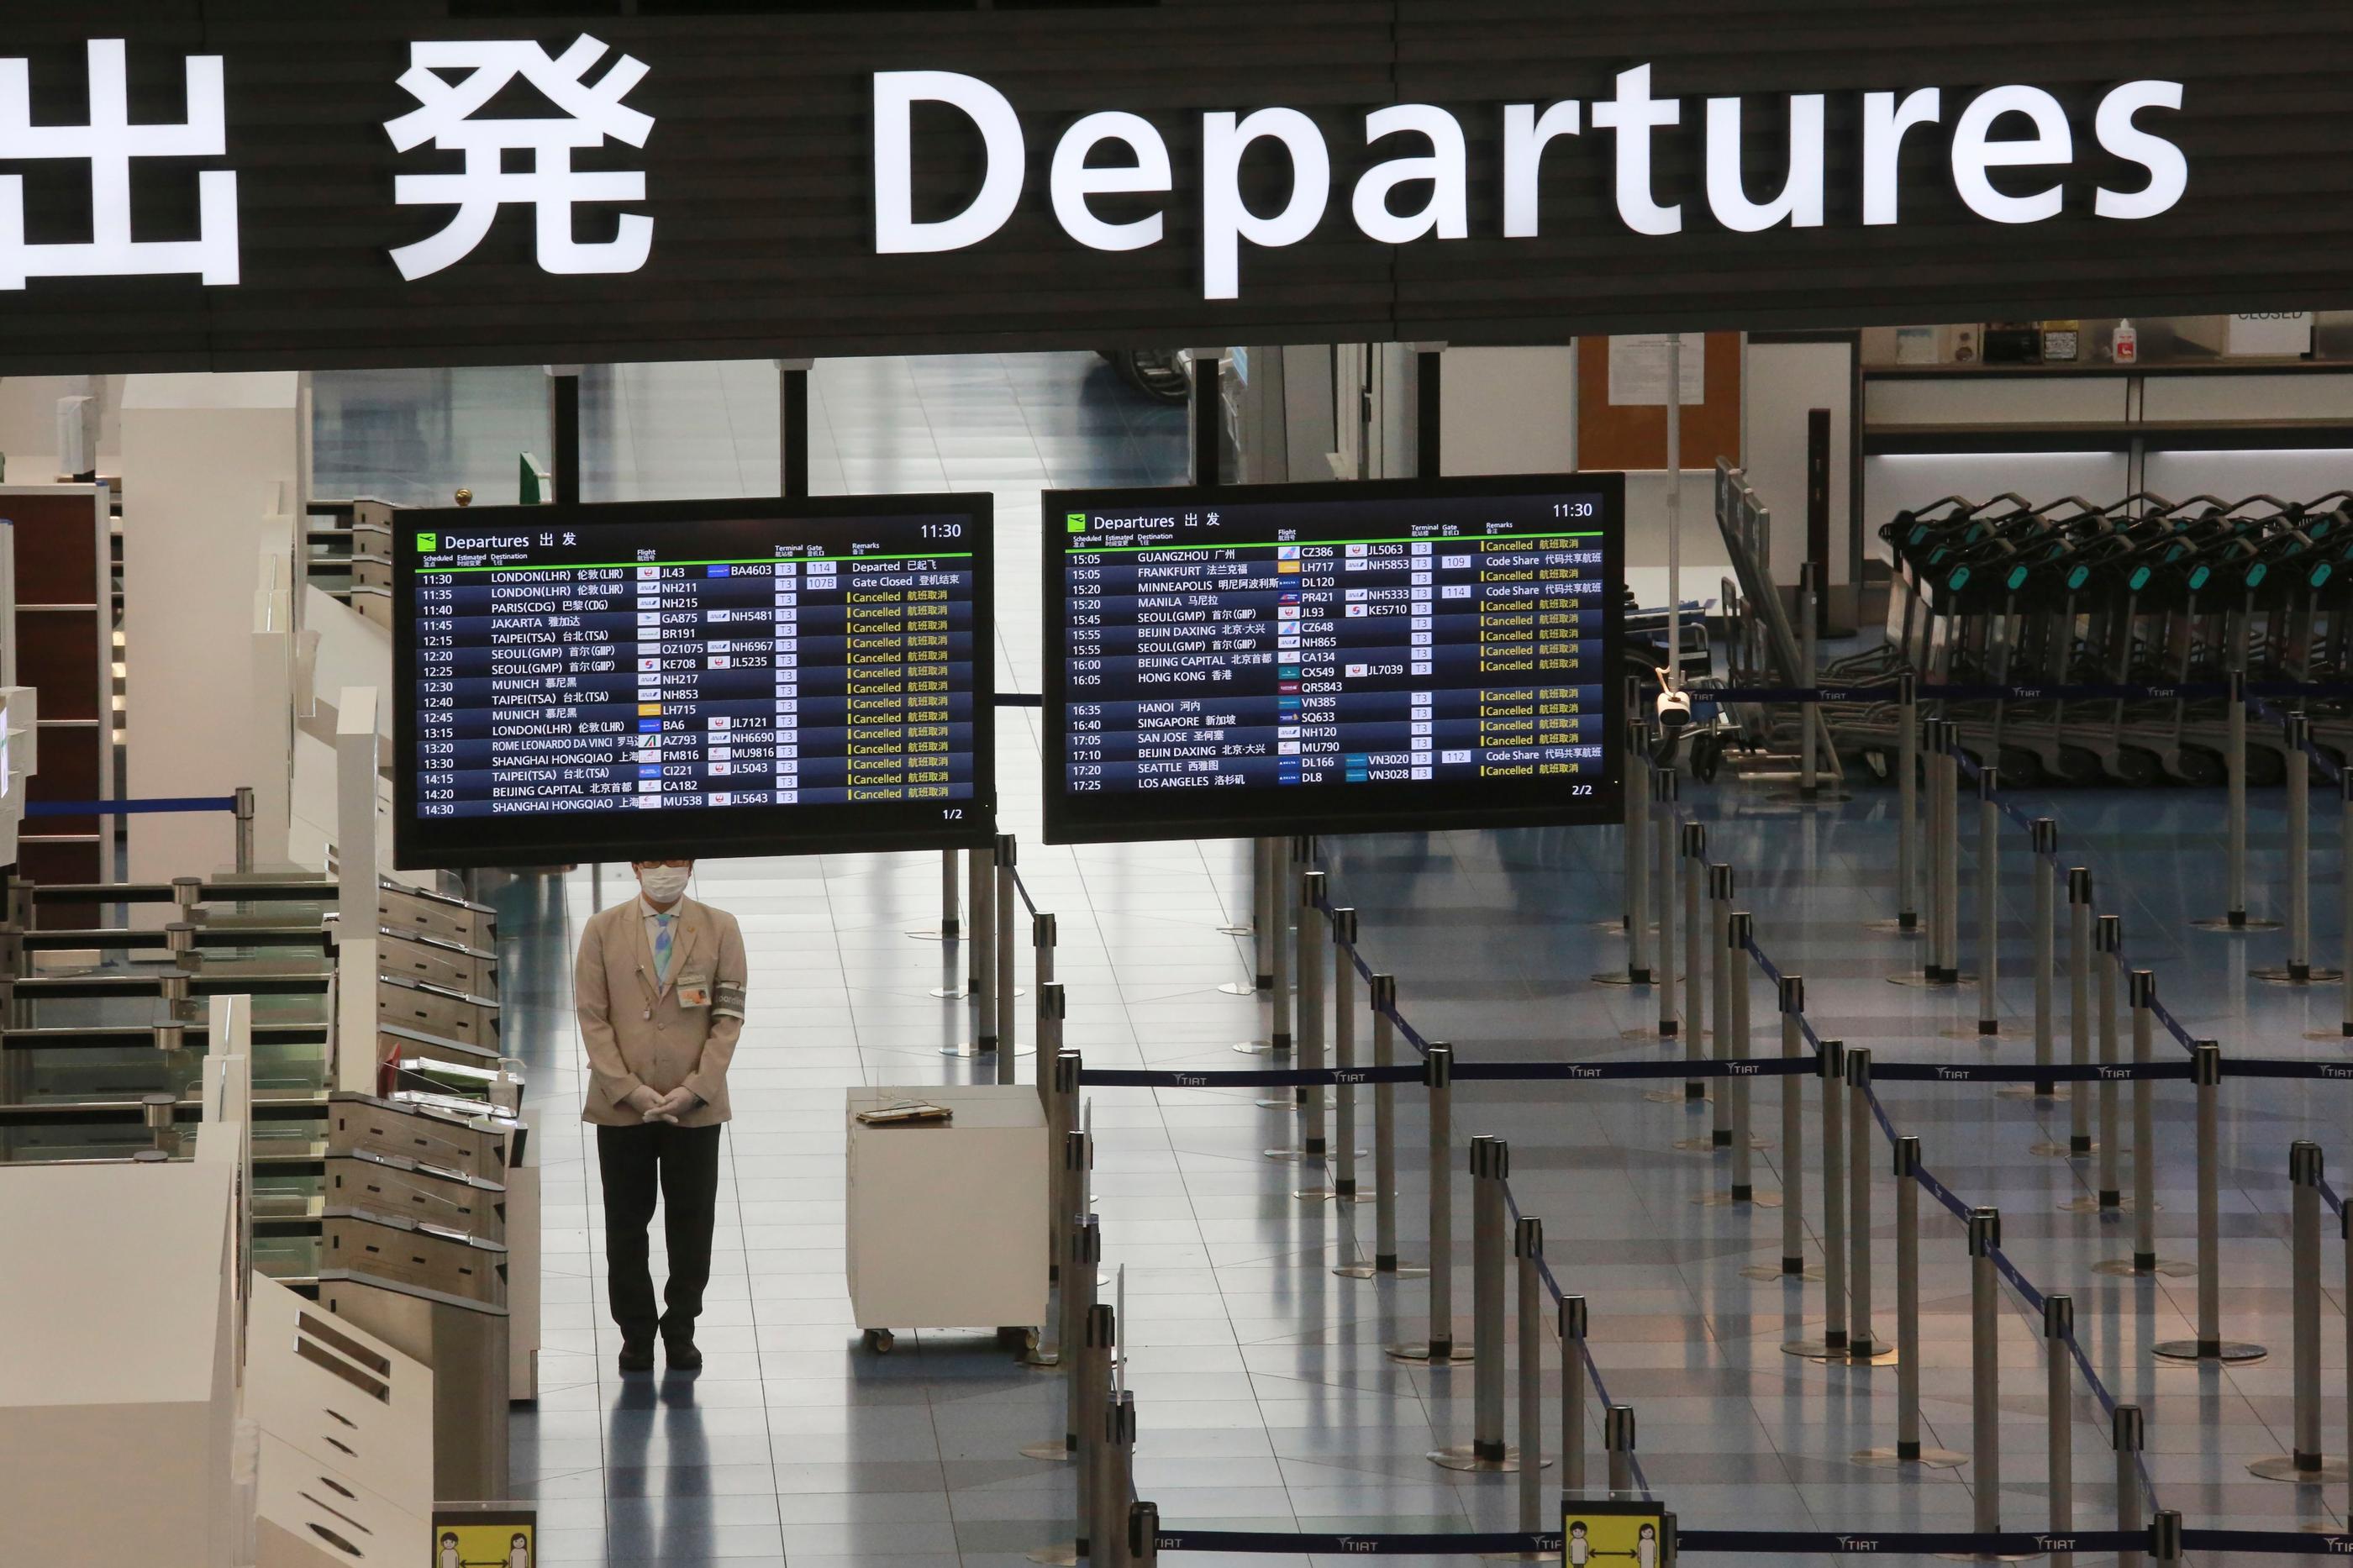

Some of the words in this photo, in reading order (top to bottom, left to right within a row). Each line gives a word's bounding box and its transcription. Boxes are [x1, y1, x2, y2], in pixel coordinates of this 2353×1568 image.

[0, 32, 655, 291] 出発
[873, 62, 2188, 300] Departures
[1094, 516, 1175, 530] Departures
[1185, 512, 1220, 527] 出发
[1553, 503, 1592, 518] 11:30
[445, 535, 529, 550] Departures
[540, 532, 576, 547] 出发
[921, 524, 961, 538] 11:30
[1073, 534, 1102, 543] Scheduled
[1105, 534, 1134, 542] Estimated
[1137, 533, 1173, 541] Destination
[1278, 529, 1297, 537] Flight
[1486, 521, 1513, 529] Remarks
[637, 549, 656, 557] Flight
[1073, 555, 1101, 565] 15:05
[1138, 550, 1208, 562] GUANGZHOU
[1302, 547, 1334, 557] CZ386
[1368, 545, 1403, 555] JL5063
[1487, 540, 1533, 551] Cancelled
[423, 574, 452, 585] 11:30
[492, 570, 571, 583] LONDON(LHR)
[661, 567, 685, 578] JL43
[731, 565, 772, 576] BA4603
[813, 563, 830, 572] 114
[852, 560, 900, 573] Departed
[1073, 570, 1100, 580] 15:05
[1138, 566, 1202, 577] FRANKFURT
[1302, 562, 1334, 572] LH717
[1369, 559, 1409, 571] NH5853
[1448, 557, 1465, 567] 109
[1486, 556, 1511, 566] Code
[1513, 555, 1540, 566] Share
[424, 590, 452, 600] 11:35
[492, 586, 571, 598] LONDON(LHR)
[662, 582, 697, 593] NH211
[809, 578, 834, 588] 107B
[852, 577, 877, 587] Gate
[880, 576, 913, 587] Closed
[1073, 584, 1101, 595] 15:20
[1138, 581, 1213, 592] MINNEAPOLIS
[1302, 576, 1334, 587] DL120
[1486, 570, 1533, 581] Cancelled
[1073, 599, 1101, 610] 15:20
[1138, 597, 1182, 608] MANILA
[1302, 592, 1333, 602] PR421
[1369, 589, 1409, 600] NH5333
[1448, 587, 1465, 597] 114
[1486, 586, 1511, 597] Code
[1513, 585, 1540, 596] Share
[424, 620, 452, 631] 11:45
[491, 618, 543, 629] JAKARTA
[661, 613, 697, 624] GA875
[731, 611, 772, 622] NH5481
[852, 607, 901, 618] Cancelled
[424, 651, 453, 661] 12:20
[492, 647, 562, 660] SEOUL(GMP)
[662, 644, 703, 655] OZ1075
[732, 641, 774, 652] NH6967
[853, 637, 901, 648] Cancelled
[424, 681, 453, 692] 12:30
[492, 679, 540, 690] MUNICH
[663, 674, 698, 685] NH217
[853, 667, 901, 678] Cancelled
[1073, 675, 1101, 685] 16:05
[1138, 672, 1171, 683] HONG
[1174, 671, 1206, 681] KONG
[1302, 667, 1334, 677] CX549
[1368, 665, 1403, 676] JL7039
[1486, 660, 1533, 671] Cancelled
[1302, 681, 1343, 693] QR5843
[424, 713, 453, 723] 12:45
[492, 709, 540, 721] MUNICH
[663, 704, 696, 715] LH715
[853, 697, 902, 709] Cancelled
[1073, 720, 1101, 730] 16:40
[1138, 717, 1200, 729] SINGAPORE
[1302, 712, 1335, 723] SQ633
[1486, 705, 1533, 716] Cancelled
[424, 758, 454, 769] 13:30
[492, 755, 549, 767] SHANGHAI
[551, 753, 613, 765] HONGQIAO
[663, 750, 699, 760] FM816
[730, 747, 775, 758] MU9816
[853, 743, 902, 755] Cancelled
[1073, 750, 1101, 760] 17:10
[1139, 748, 1171, 758] BEIJIN
[1173, 745, 1216, 757] DAXING
[1302, 742, 1340, 752] MU790
[1486, 734, 1533, 746] Cancelled
[424, 789, 454, 800] 14:20
[493, 786, 534, 797] BEIJING
[537, 785, 584, 796] CAPITAL
[663, 781, 697, 792] CA182
[853, 773, 902, 785] Cancelled
[1073, 780, 1101, 791] 17:25
[1139, 778, 1159, 788] LOS
[1161, 776, 1209, 787] ANGELES
[1302, 772, 1323, 782] DL8
[1368, 769, 1409, 780] VN3028
[1486, 765, 1533, 776] Cancelled
[1572, 785, 1592, 796] 2/2
[943, 809, 962, 819] 1/2
